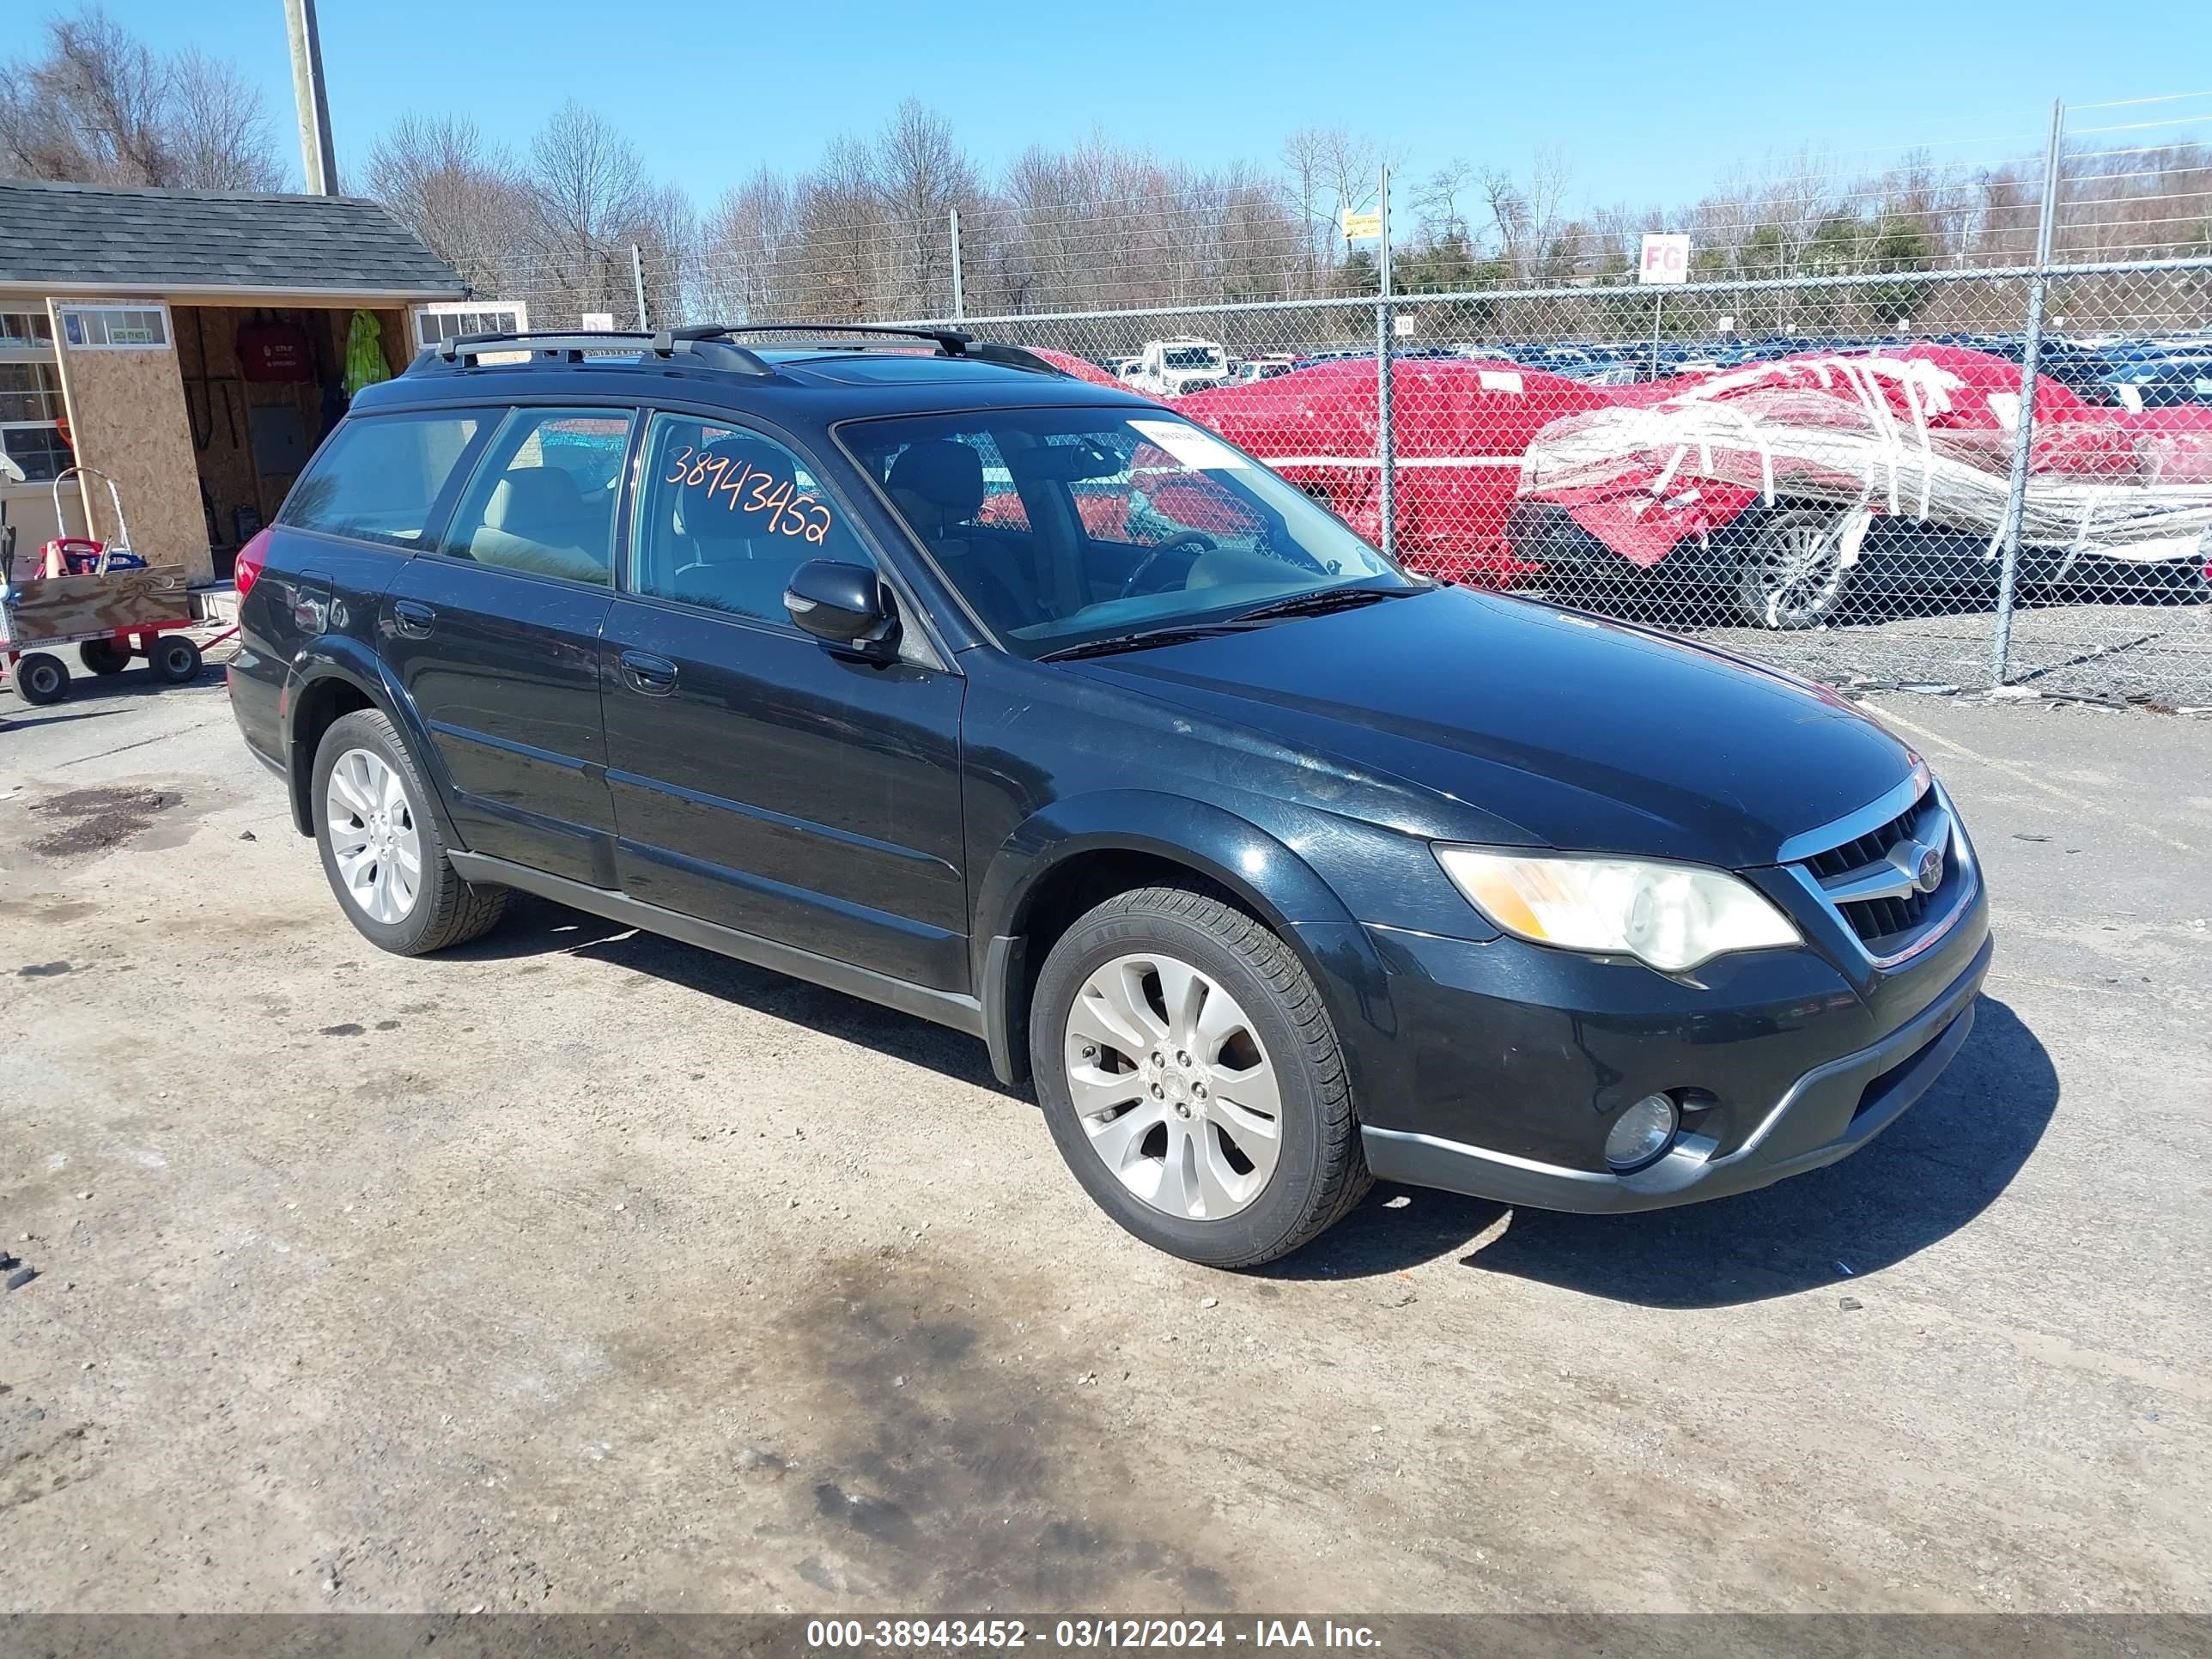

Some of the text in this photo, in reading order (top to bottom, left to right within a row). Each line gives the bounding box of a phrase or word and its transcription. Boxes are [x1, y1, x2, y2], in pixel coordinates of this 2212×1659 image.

[1646, 246, 1682, 270] FG
[1399, 320, 1411, 331] 10
[665, 445, 832, 548] 38943452
